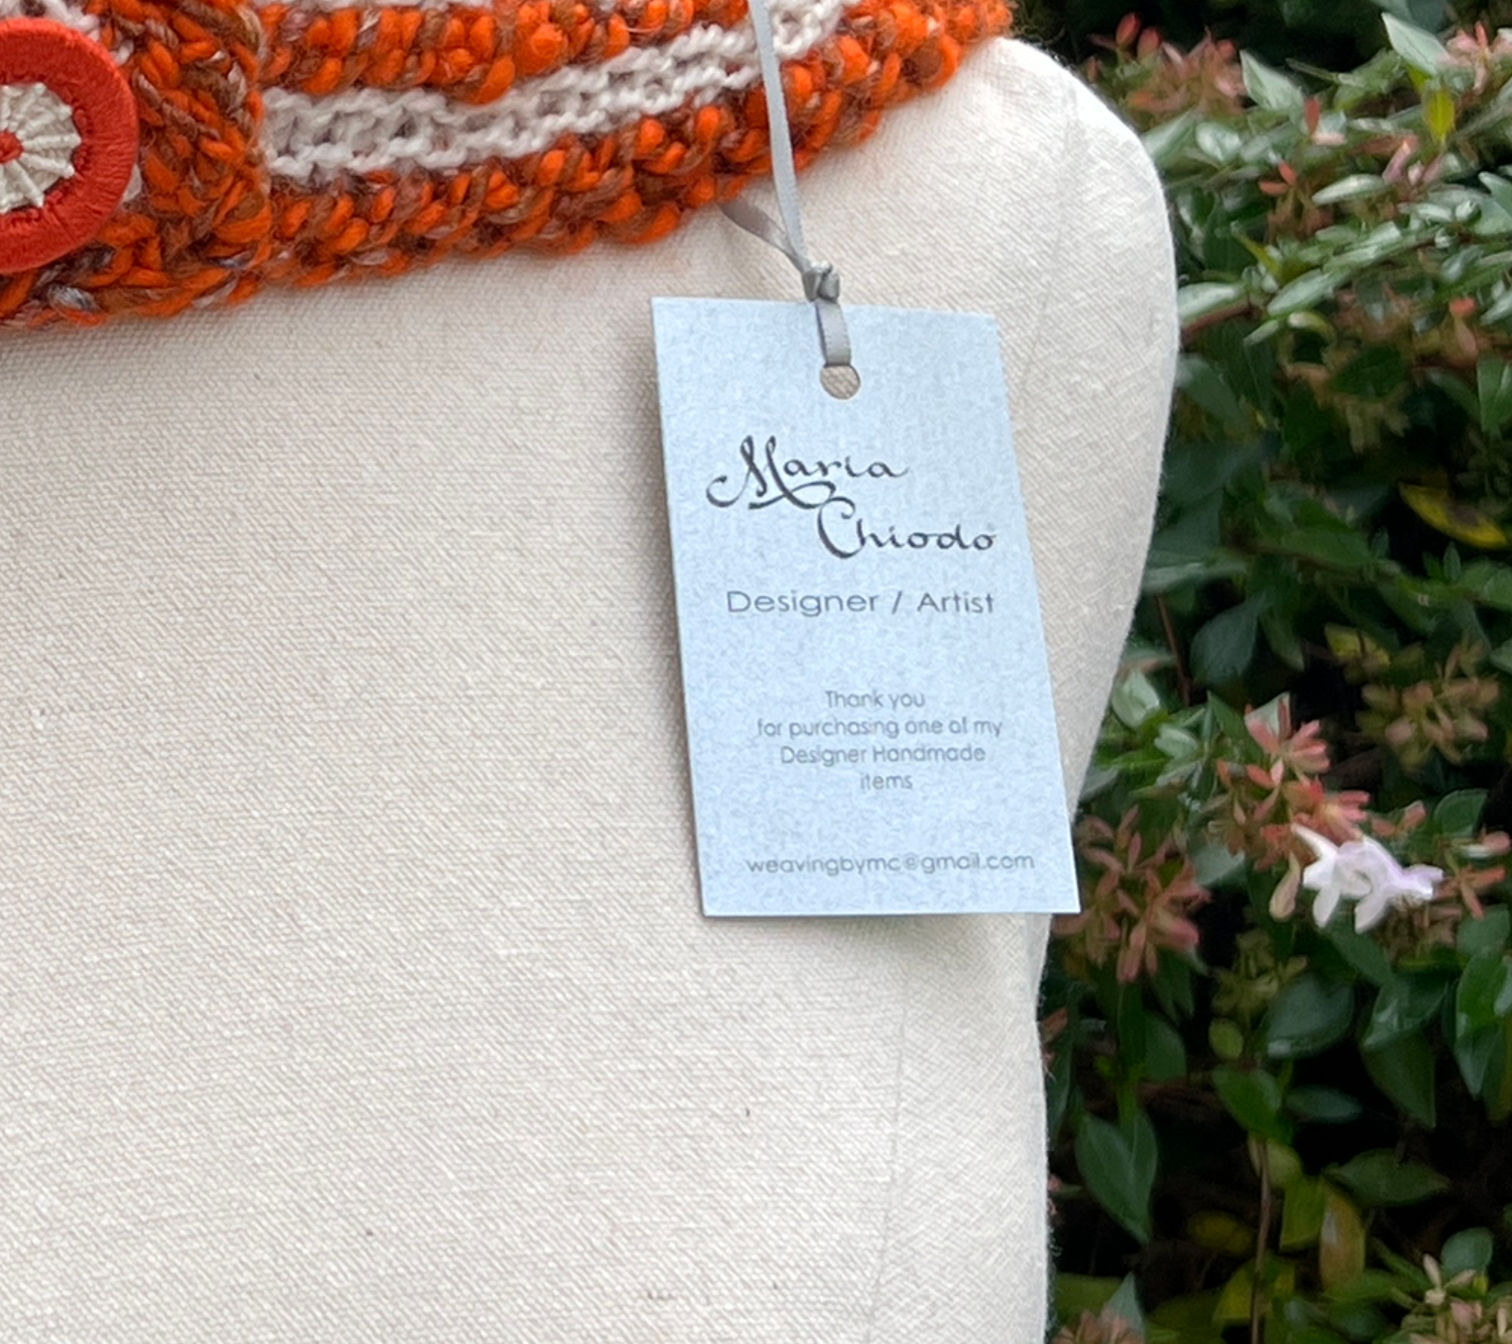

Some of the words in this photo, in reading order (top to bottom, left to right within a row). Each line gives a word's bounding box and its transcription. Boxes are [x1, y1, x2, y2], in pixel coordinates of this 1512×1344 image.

[706, 434, 909, 509] Maria
[817, 496, 996, 559] Chiodo
[726, 589, 880, 617] Designer
[891, 590, 903, 615] /
[916, 589, 996, 614] Artist
[824, 688, 884, 708] Thank
[888, 690, 926, 711] you
[756, 718, 783, 737] for
[789, 716, 900, 739] purchasing
[904, 718, 943, 735] one
[948, 716, 968, 735] of
[973, 720, 1003, 738] my
[780, 744, 867, 767] Designer
[872, 743, 986, 763] Handmade
[859, 771, 913, 790] items
[745, 852, 1036, 877] weavingbymc@gmail.com
